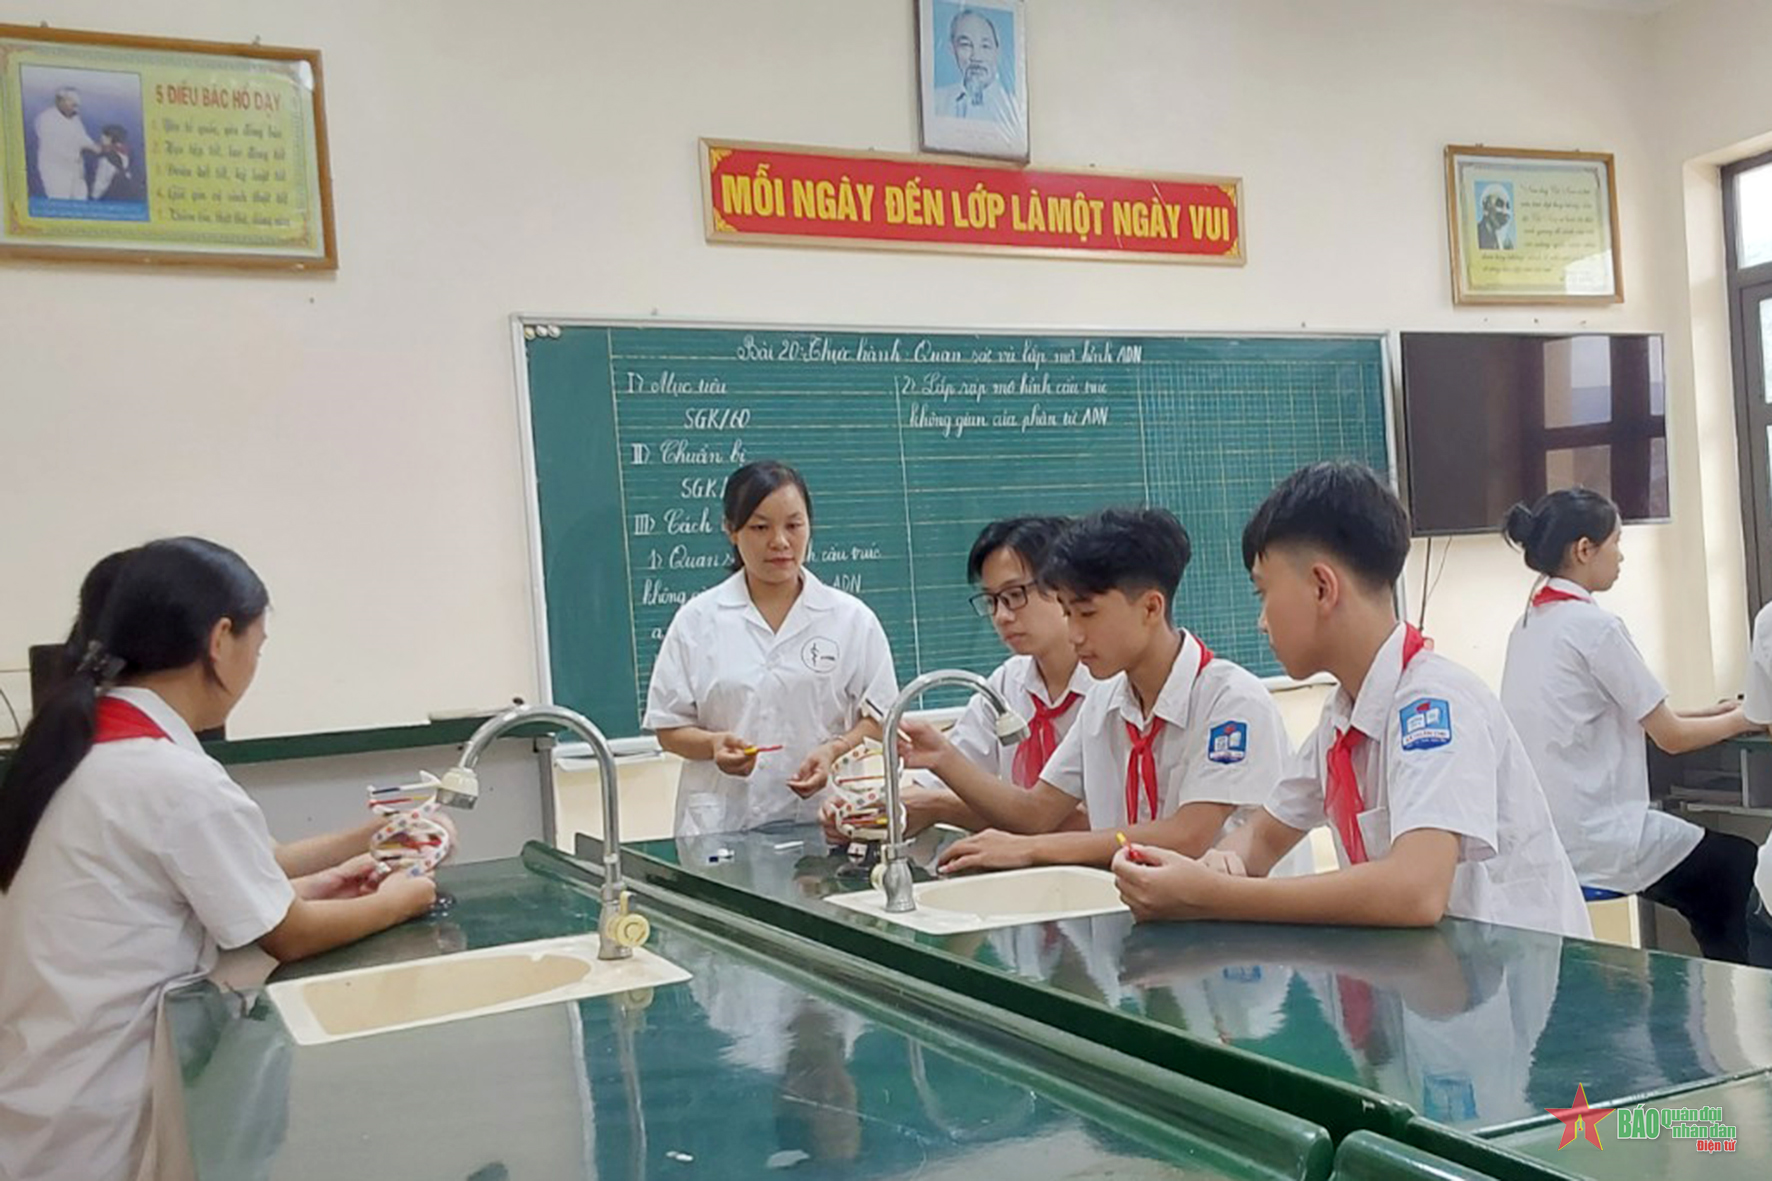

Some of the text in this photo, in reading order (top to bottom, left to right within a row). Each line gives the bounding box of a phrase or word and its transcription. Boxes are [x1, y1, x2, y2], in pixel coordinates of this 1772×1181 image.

[156, 84, 164, 104] 5
[202, 83, 229, 109] BÁC
[721, 163, 1230, 242] MỖI NGÀY ĐẾN LỚP LÀ MỘT NGÀY VUI
[736, 334, 774, 361] Bài
[914, 340, 962, 362] Quan
[1082, 339, 1113, 363] hình
[1116, 345, 1142, 363] ADN
[1019, 371, 1051, 394] hình
[683, 407, 751, 430] SGK/60
[1081, 406, 1109, 426] ADN
[659, 439, 723, 464] Chuẩn
[664, 507, 713, 535] Cách
[669, 544, 719, 569] Quan
